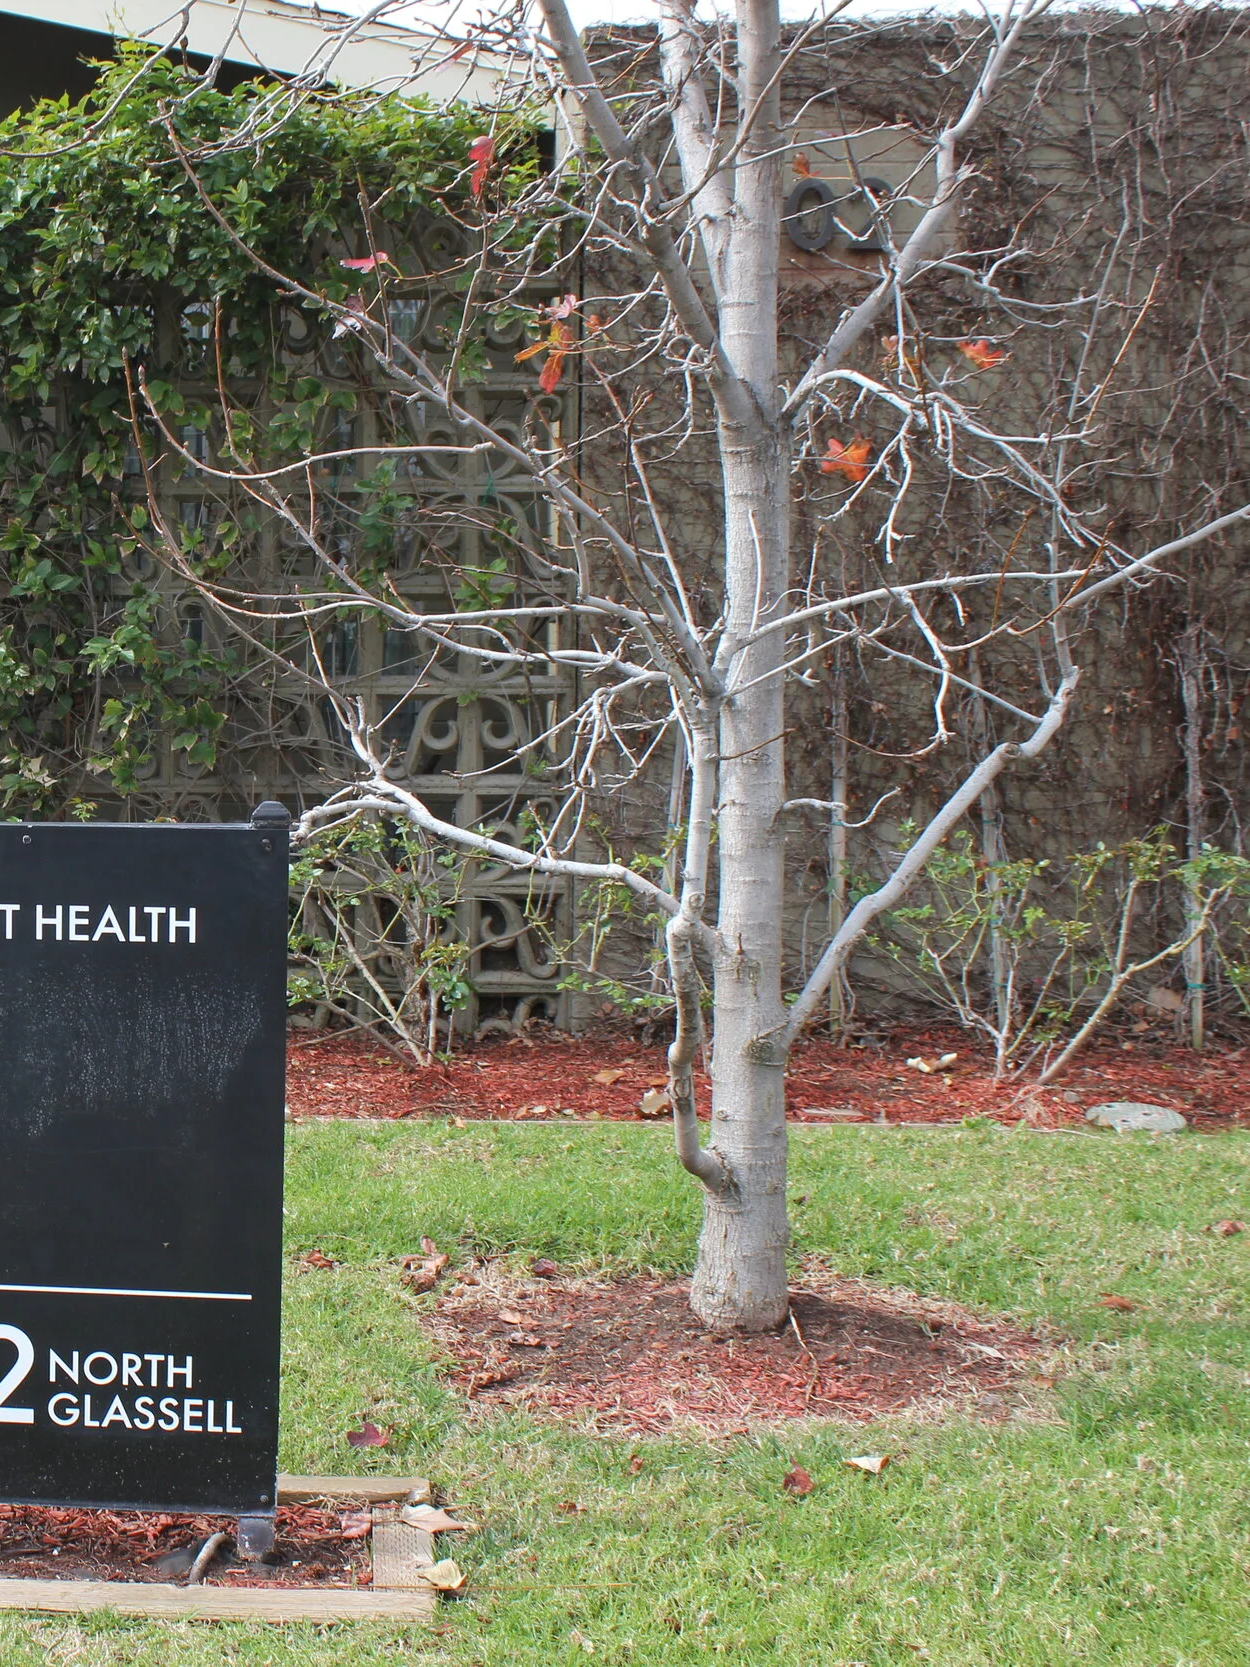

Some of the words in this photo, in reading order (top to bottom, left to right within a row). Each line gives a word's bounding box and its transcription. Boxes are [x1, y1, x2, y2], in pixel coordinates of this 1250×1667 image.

[35, 904, 197, 944] HEALTH
[49, 1348, 193, 1389] NORTH
[47, 1392, 242, 1434] GLASSELL
